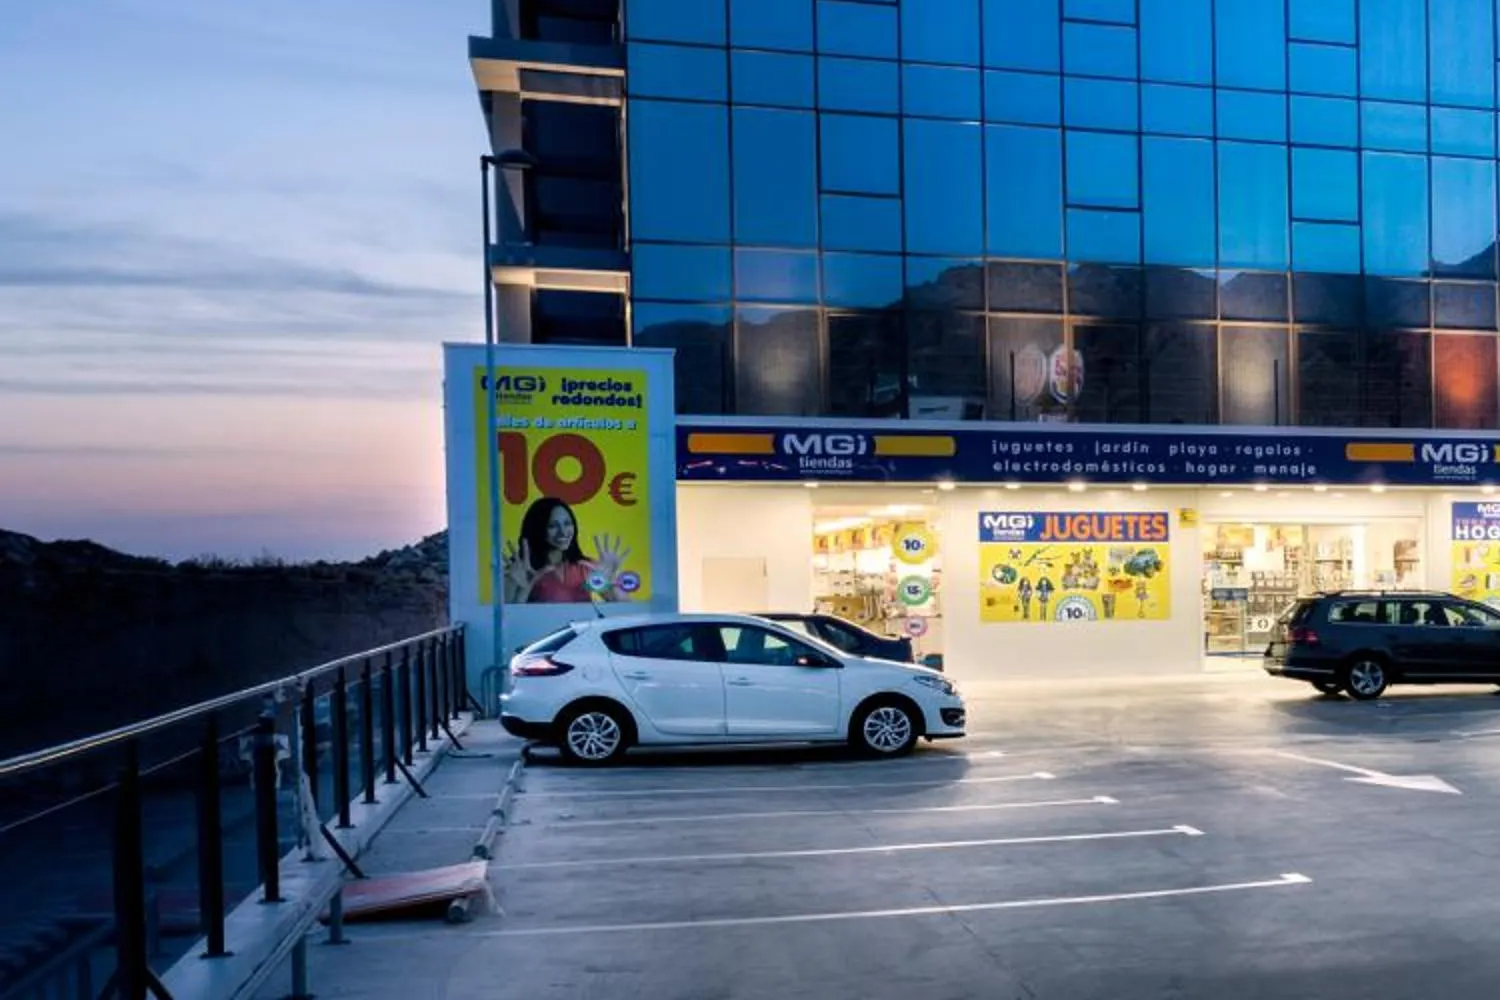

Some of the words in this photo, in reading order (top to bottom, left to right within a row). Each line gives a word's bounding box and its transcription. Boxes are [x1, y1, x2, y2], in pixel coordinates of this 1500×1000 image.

[991, 439, 1074, 455] juguetes
[1169, 441, 1217, 457] playa
[1235, 443, 1301, 459] regalos
[799, 455, 853, 469] tiendas
[1185, 461, 1237, 477] hogar
[1253, 462, 1317, 478] menaje
[1039, 514, 1168, 541] JUGUETES
